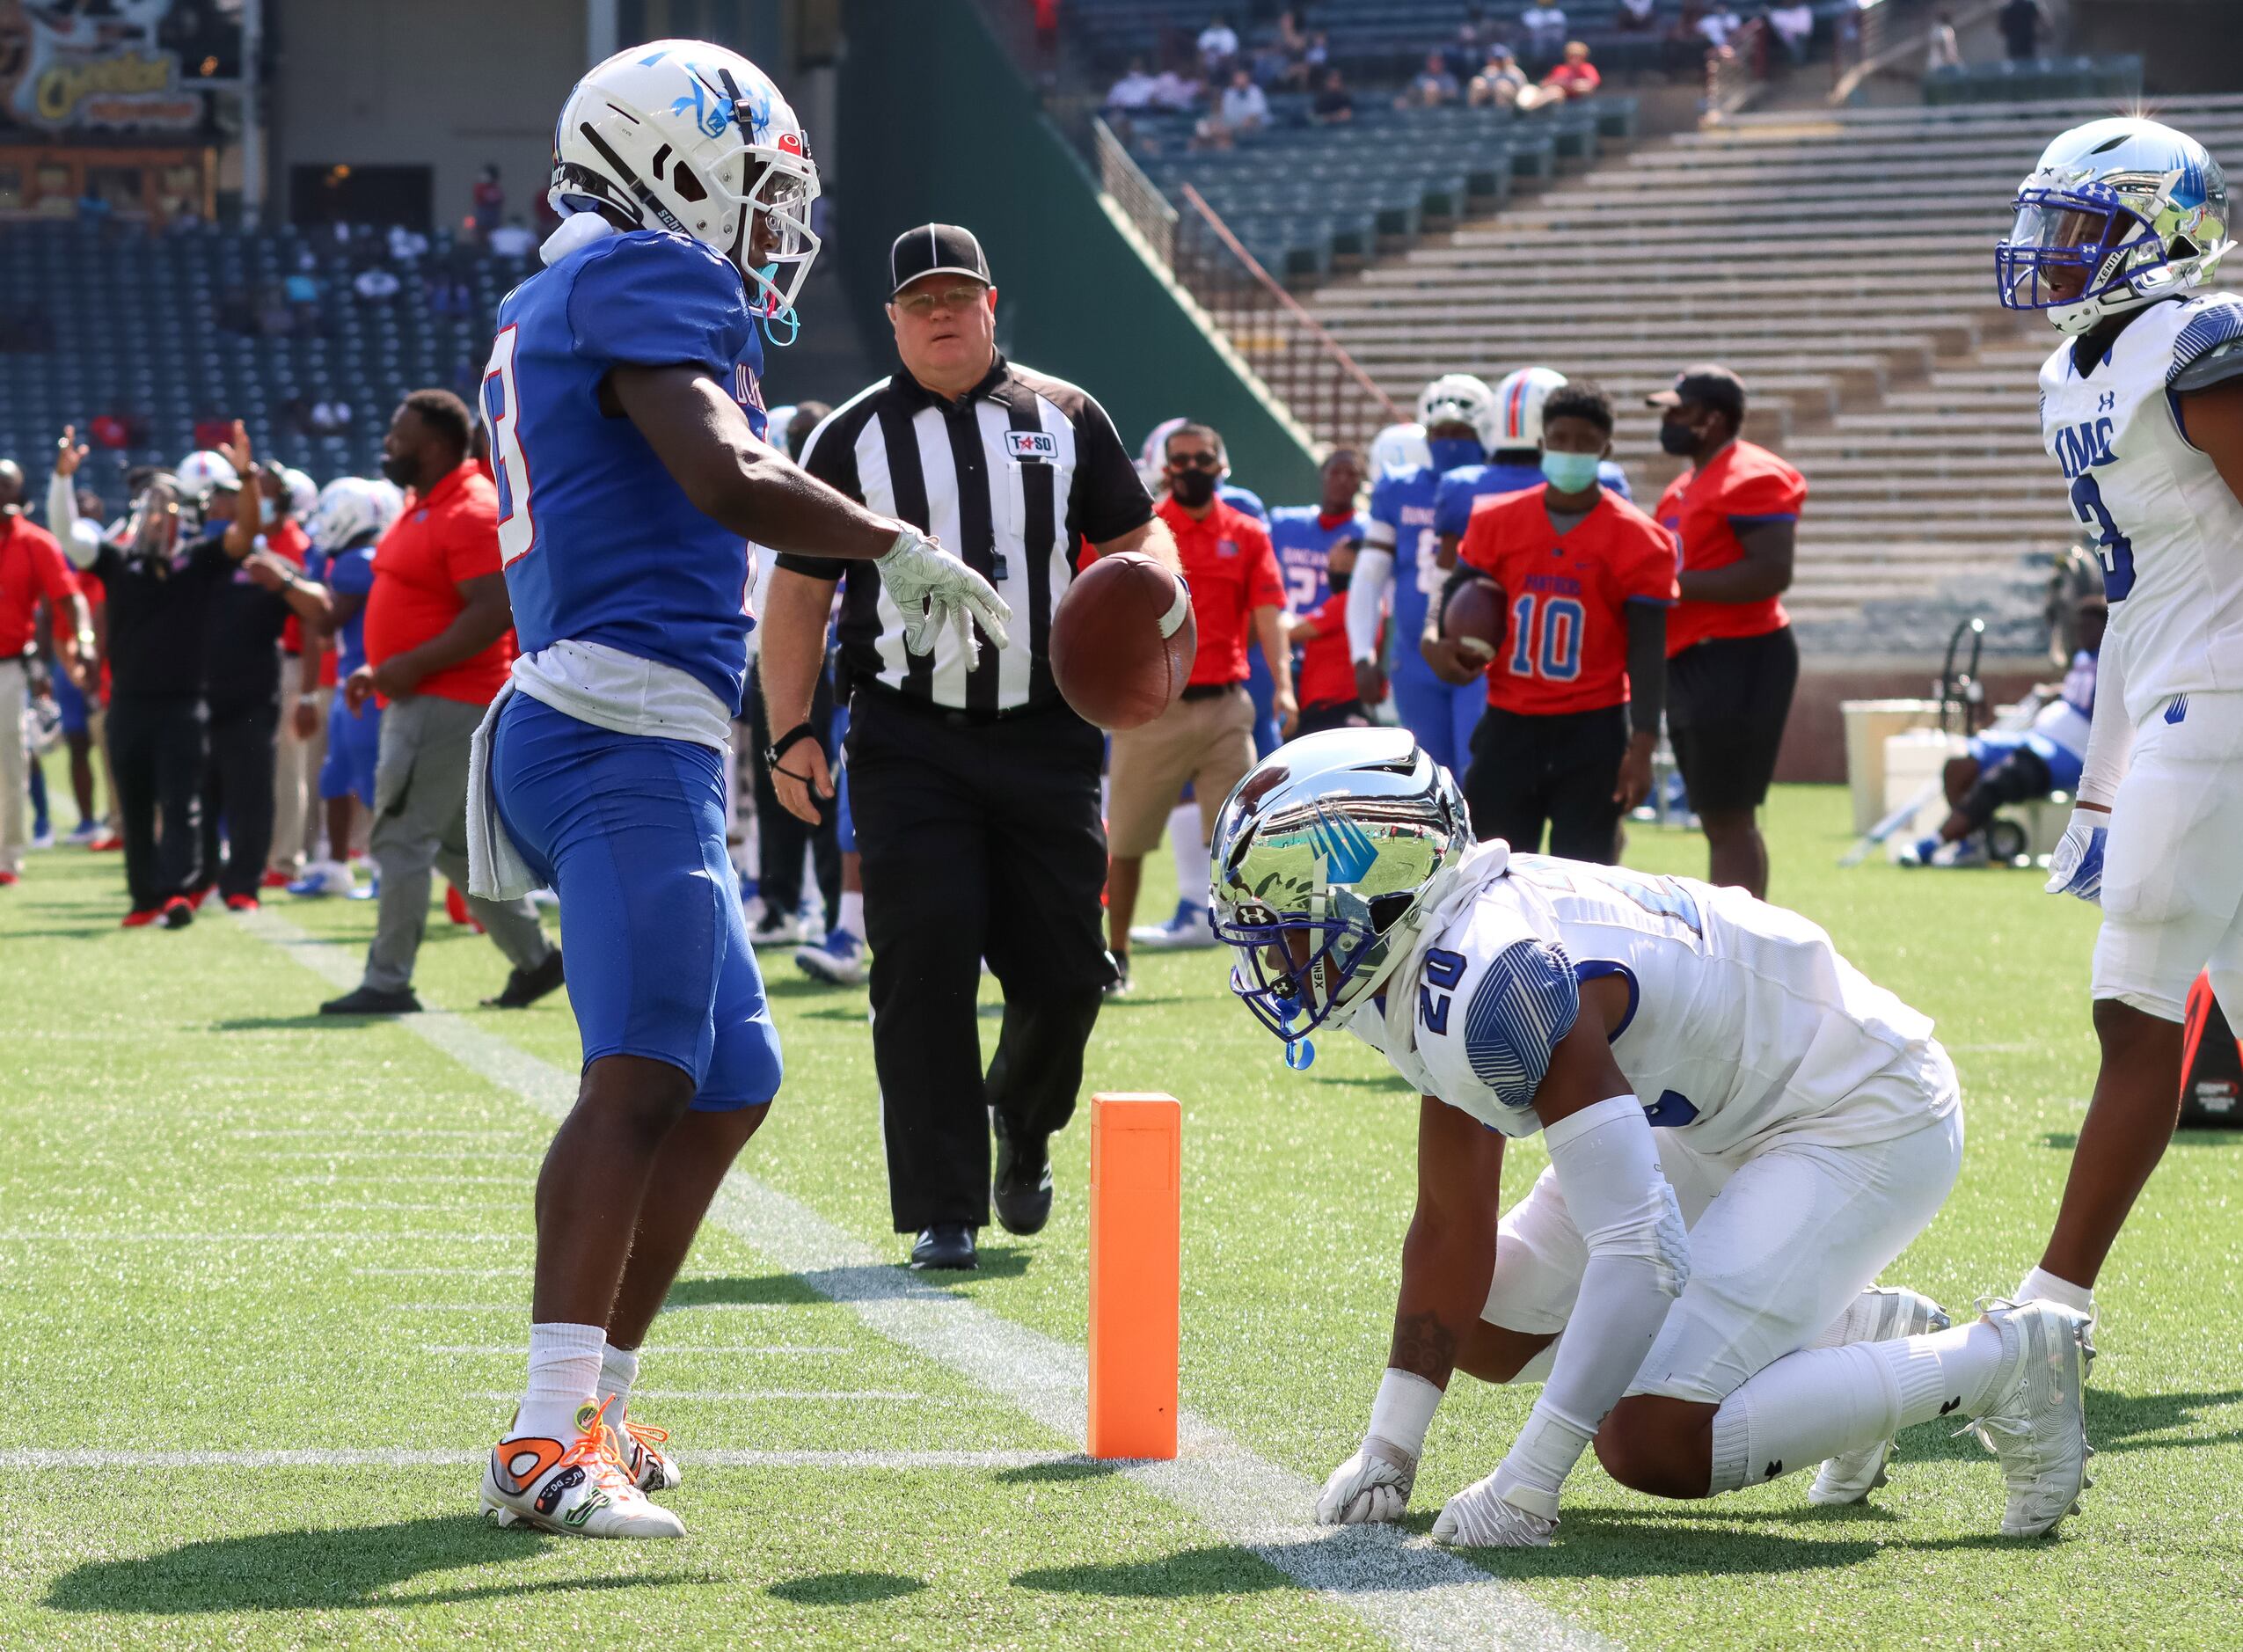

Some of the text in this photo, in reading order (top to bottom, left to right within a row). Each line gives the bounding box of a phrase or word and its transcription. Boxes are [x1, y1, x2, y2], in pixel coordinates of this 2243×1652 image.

[2055, 417, 2120, 479] IMG
[1509, 593, 1586, 683] 10
[1419, 947, 1468, 1036] 20
